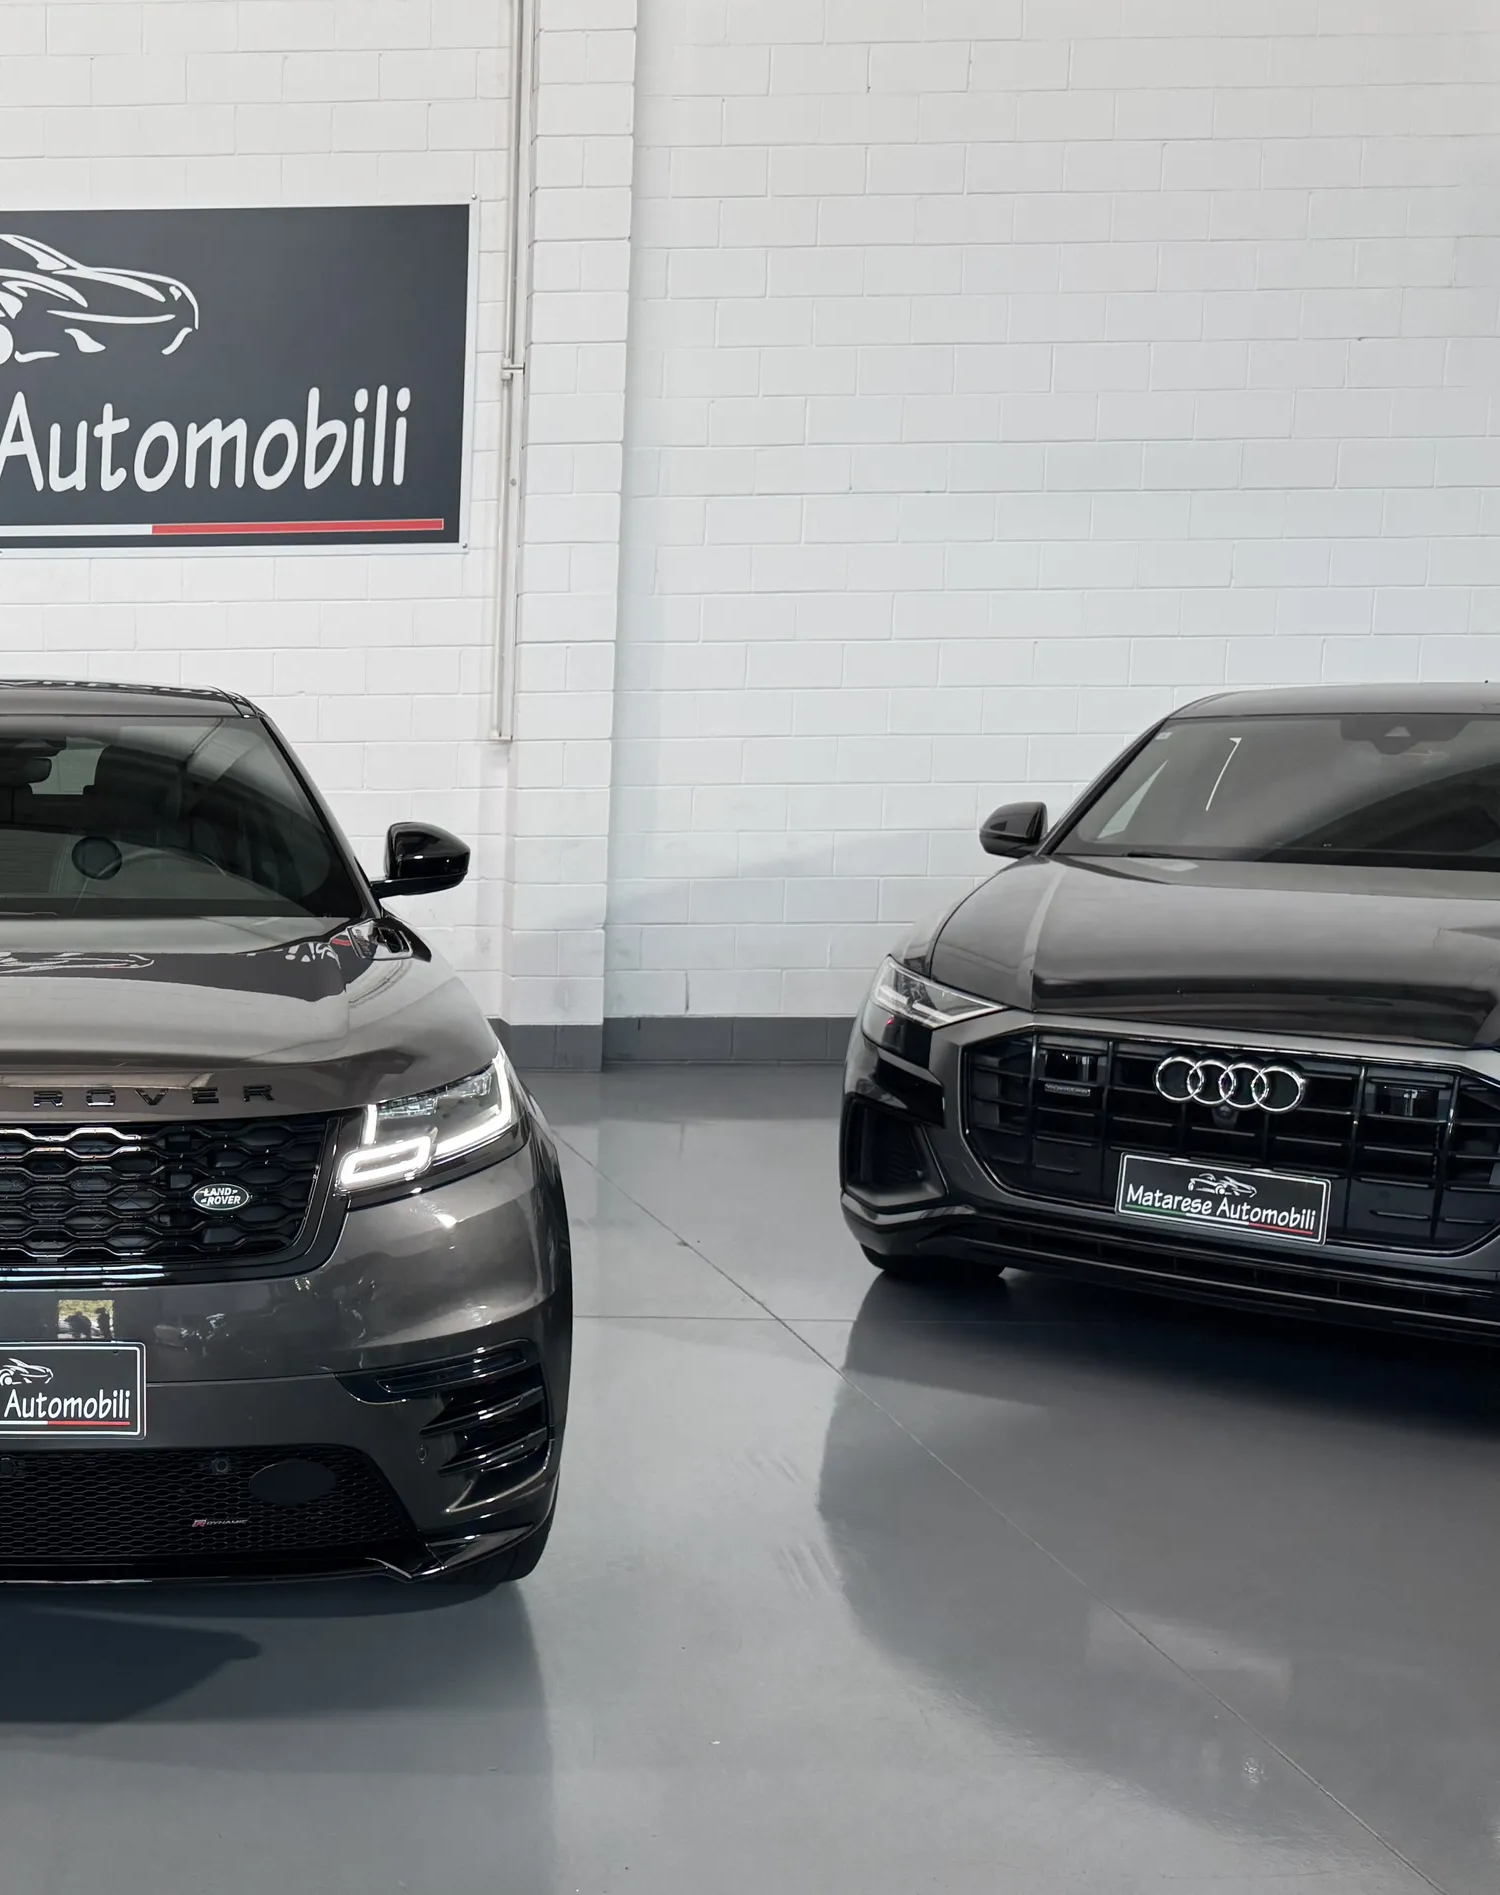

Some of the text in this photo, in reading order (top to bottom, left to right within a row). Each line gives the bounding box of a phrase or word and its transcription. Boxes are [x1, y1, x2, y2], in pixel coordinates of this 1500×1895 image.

[33, 1084, 275, 1108] ROVER
[203, 1187, 232, 1197] LAND
[207, 1195, 241, 1206] ROVER
[1125, 1183, 1316, 1230] Matarese Automobili
[3, 1388, 131, 1419] Automobili
